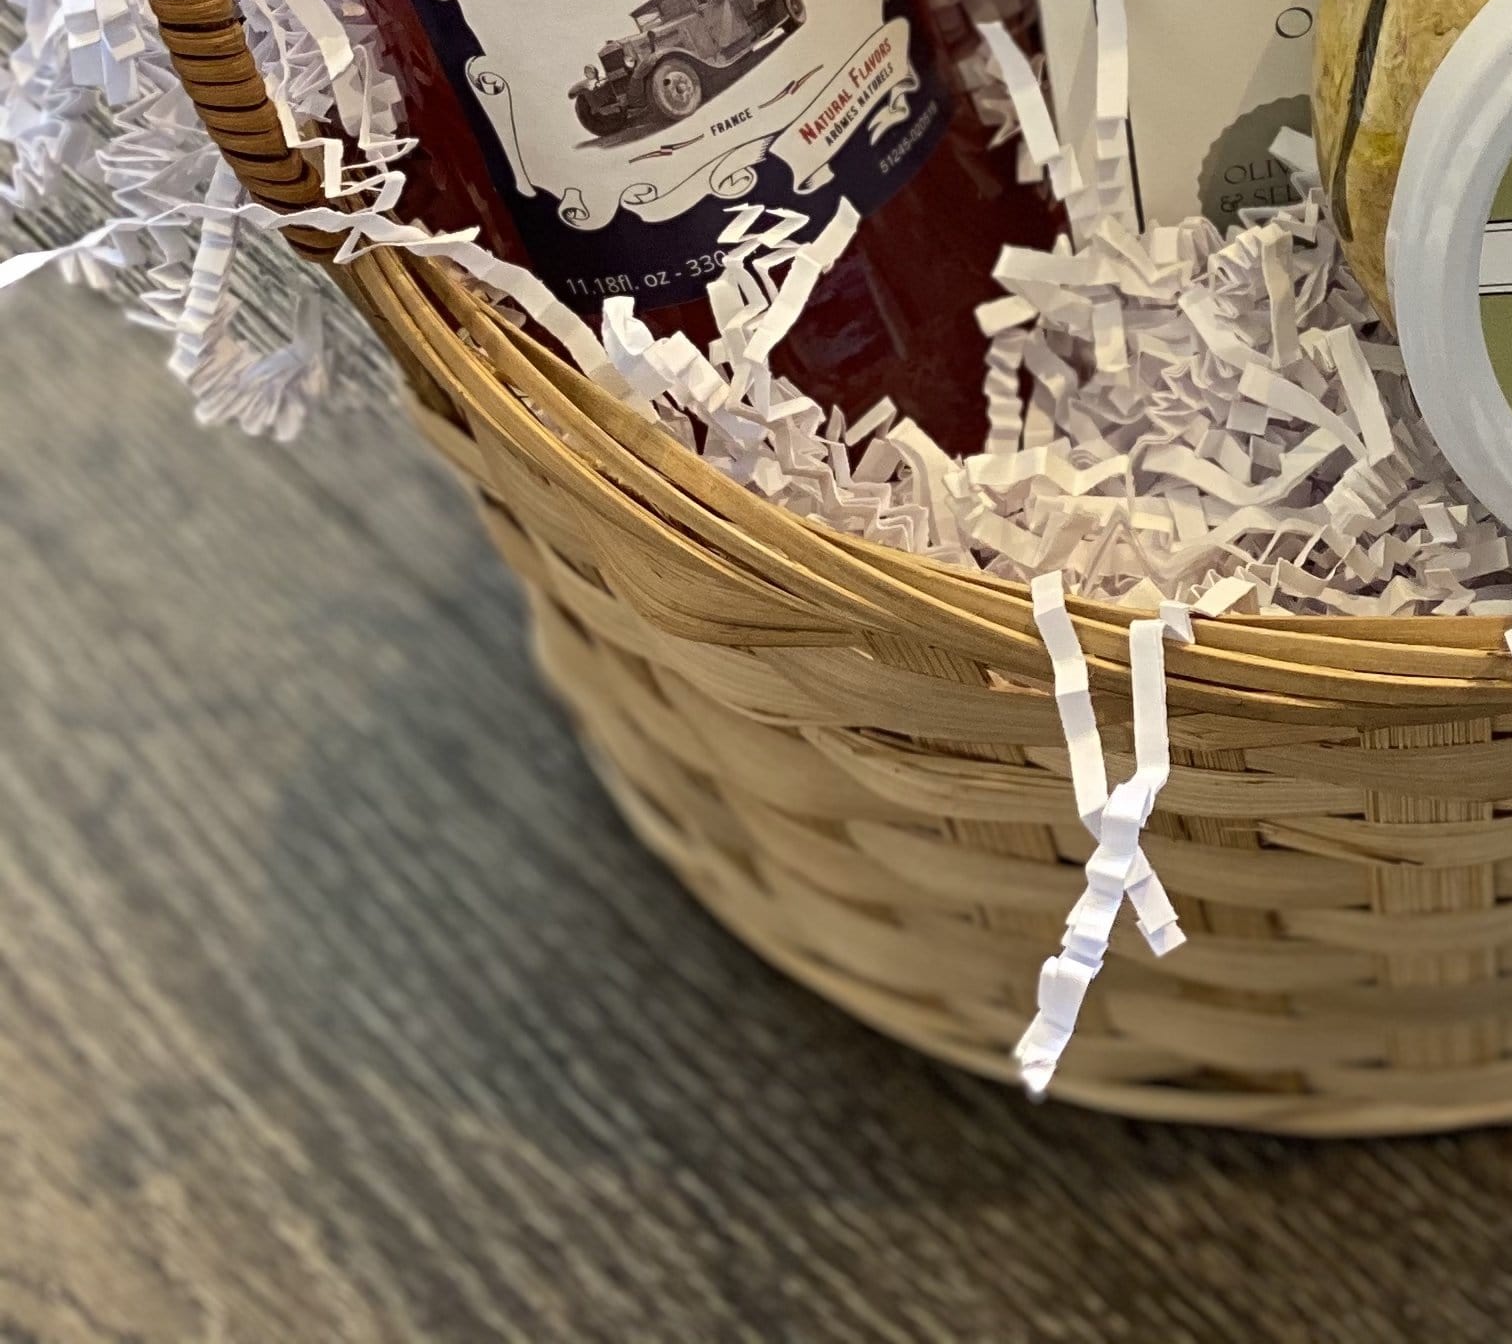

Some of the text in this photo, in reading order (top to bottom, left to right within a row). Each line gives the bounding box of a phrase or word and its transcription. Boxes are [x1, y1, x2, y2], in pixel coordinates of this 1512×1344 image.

[798, 37, 892, 145] NATURAL FLAVORS
[825, 62, 894, 147] ARÔMES NATURELS
[710, 108, 753, 137] FRANCE
[644, 270, 671, 289] oz
